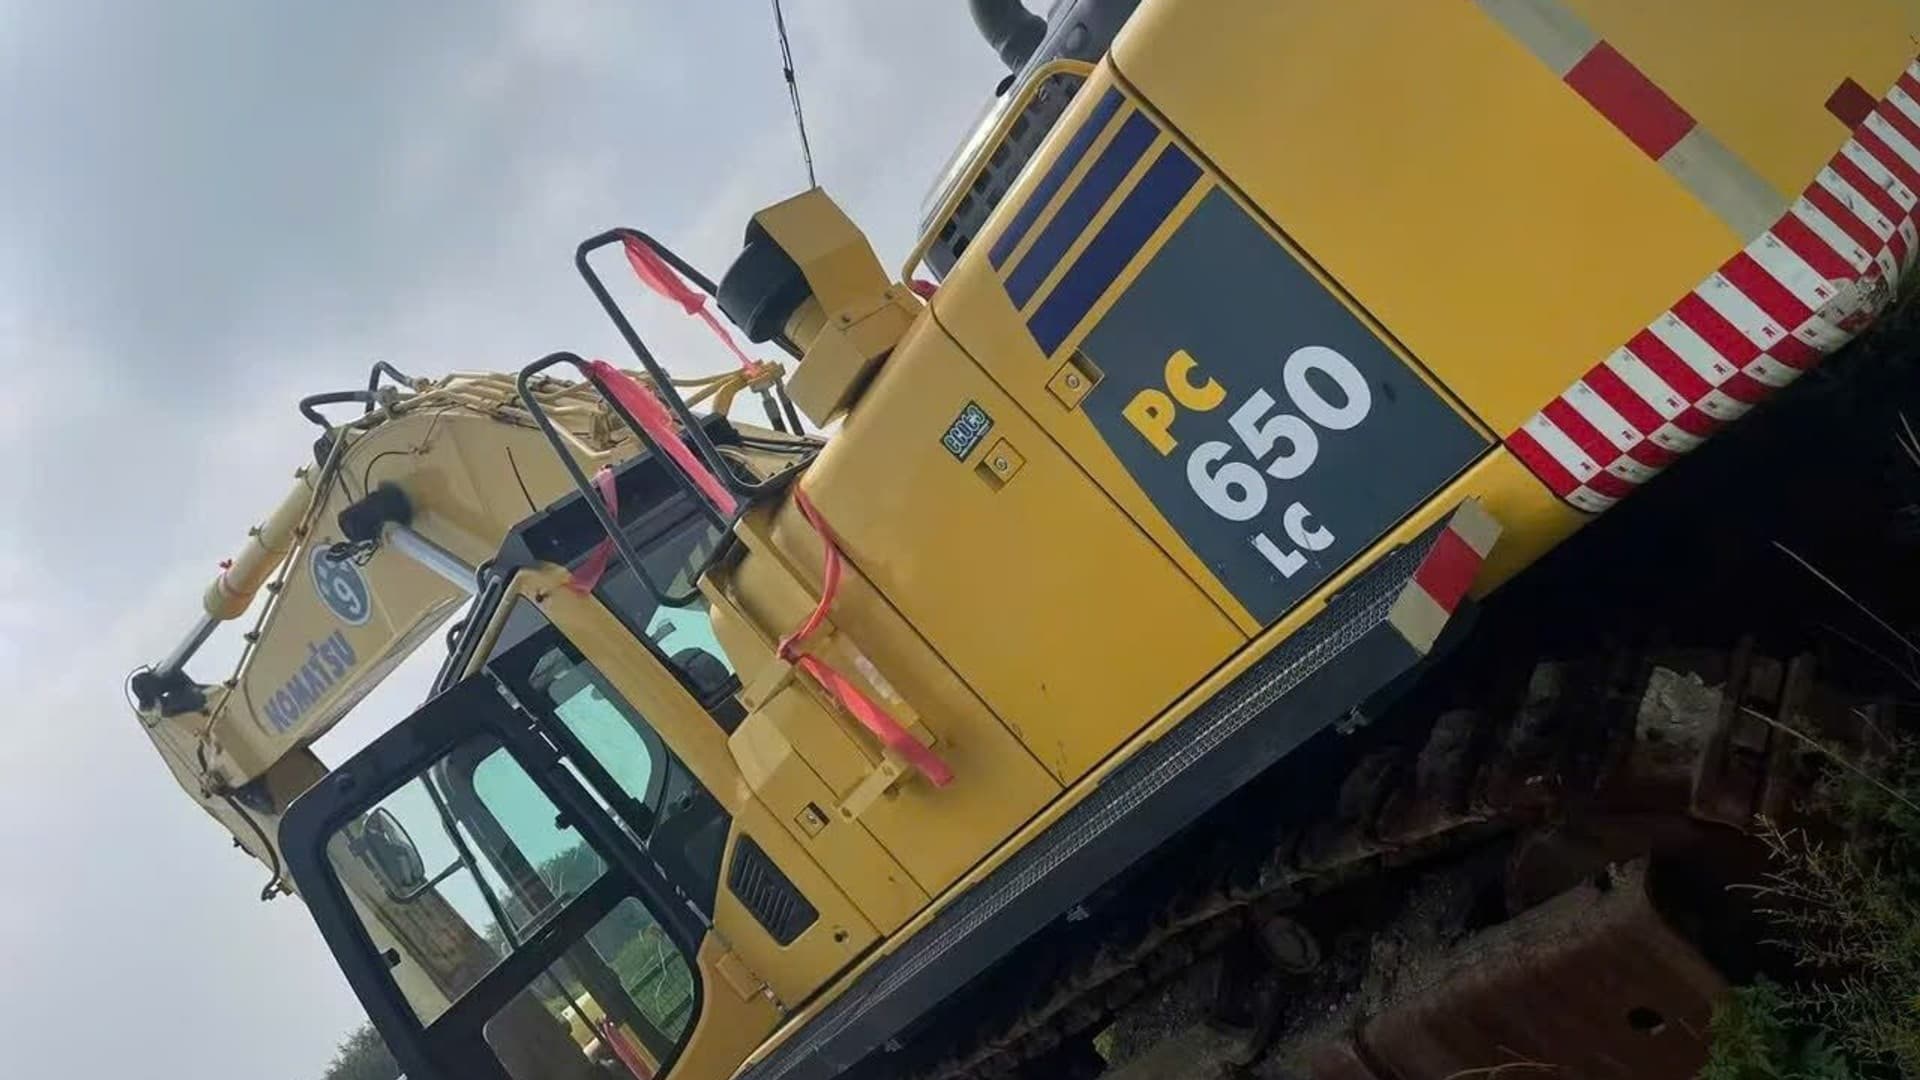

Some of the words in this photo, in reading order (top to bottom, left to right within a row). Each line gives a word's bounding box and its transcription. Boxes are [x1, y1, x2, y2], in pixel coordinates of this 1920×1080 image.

[1122, 349, 1228, 457] PC
[1187, 345, 1372, 522] 650
[1251, 501, 1336, 579] LC
[263, 629, 358, 736] KOMATSU
